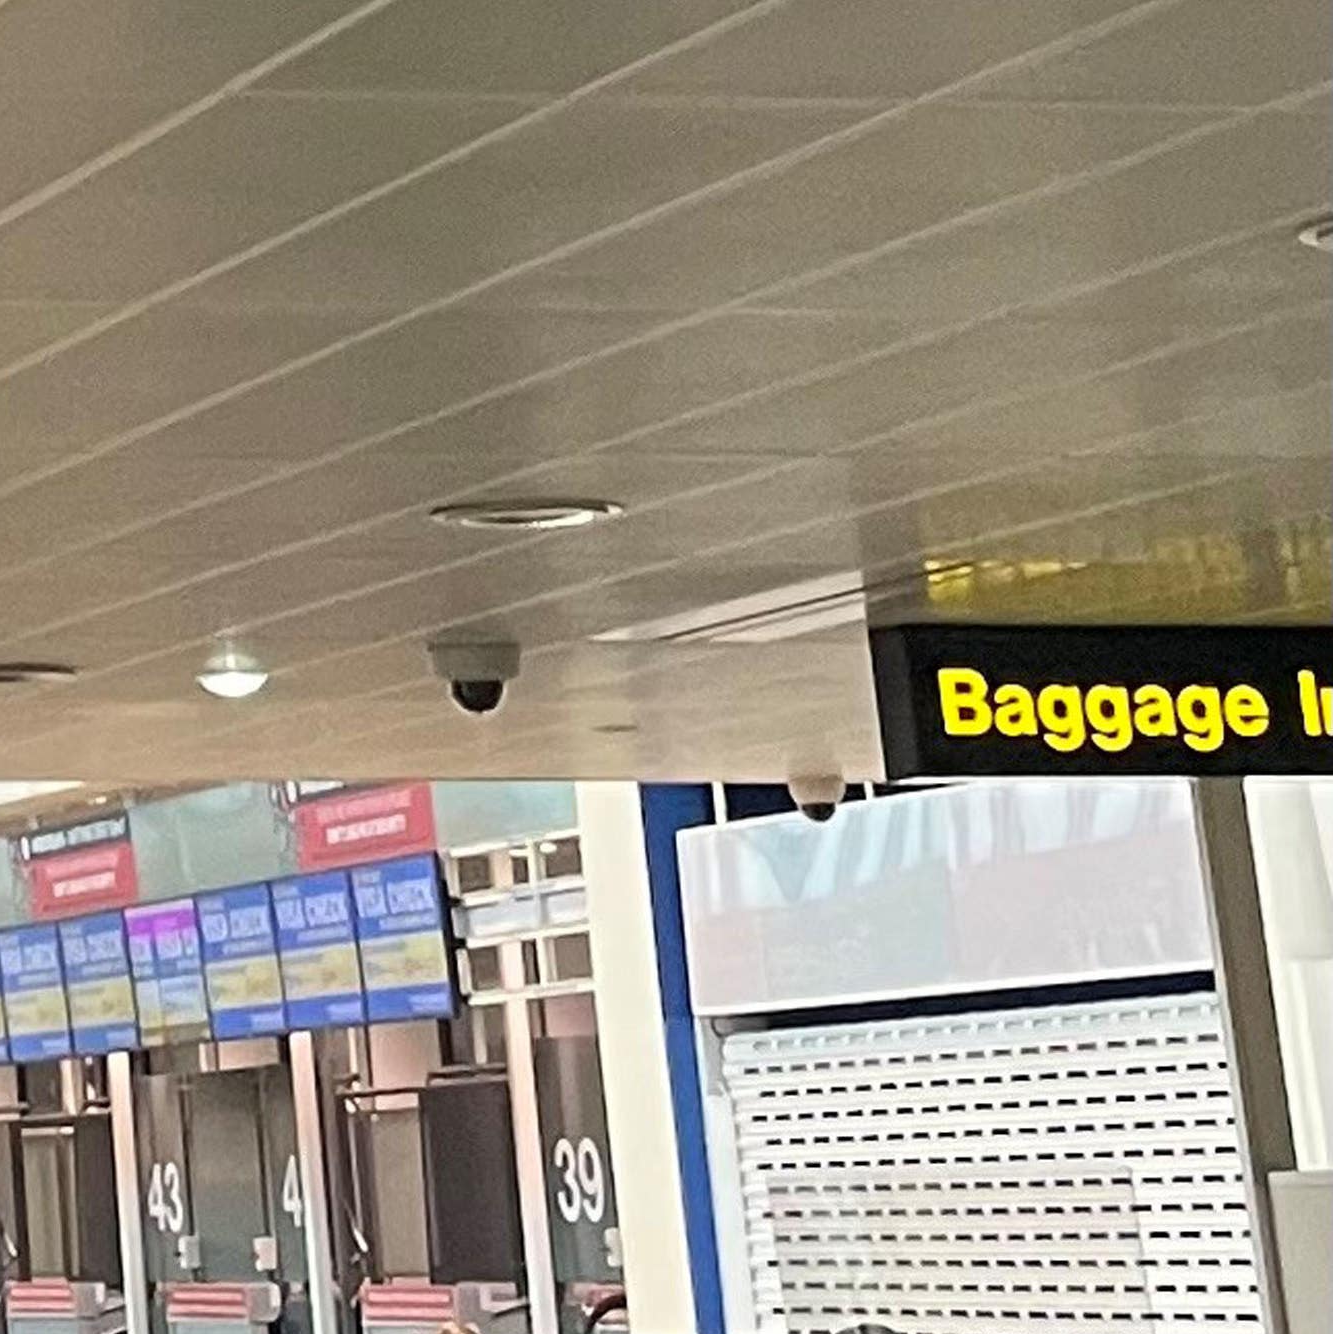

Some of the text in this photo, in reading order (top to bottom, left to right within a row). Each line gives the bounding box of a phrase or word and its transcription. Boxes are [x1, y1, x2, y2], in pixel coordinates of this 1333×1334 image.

[937, 667, 1269, 752] Baggage
[146, 1161, 186, 1234] 43
[279, 1152, 301, 1228] 4
[553, 1137, 606, 1223] 39
